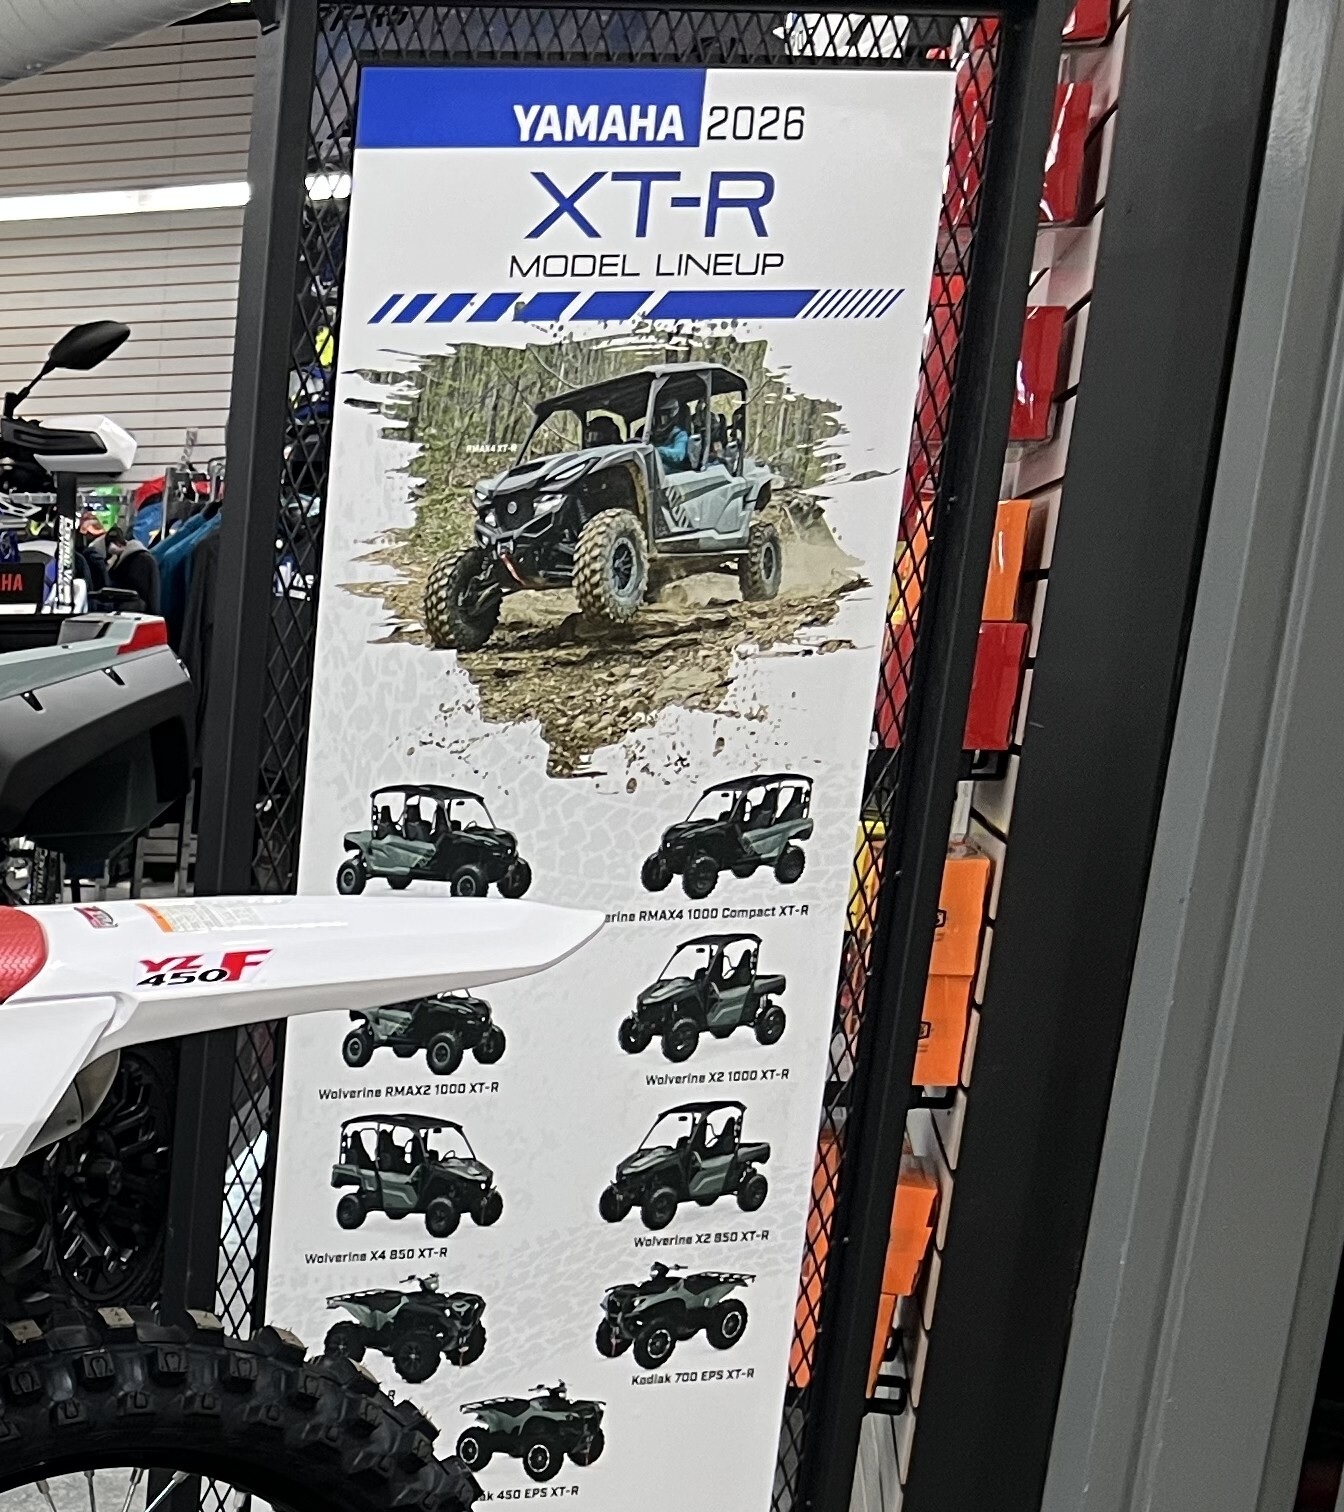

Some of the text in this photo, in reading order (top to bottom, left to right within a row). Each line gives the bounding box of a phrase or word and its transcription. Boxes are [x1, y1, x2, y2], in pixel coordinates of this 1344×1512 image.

[513, 104, 806, 142] YAMAHA 2026
[523, 170, 776, 239] XT-R
[509, 253, 785, 278] MODEL LINEUP
[638, 909, 684, 922] RMAX4
[687, 907, 718, 920] 1000
[721, 905, 776, 920] Compact
[778, 904, 810, 917] XT-R
[136, 968, 228, 987] 450
[645, 1068, 790, 1086] Wolverine X2 1000 XT-R
[318, 1081, 499, 1100] Wolverine RMAX2 1000 XT-R
[633, 1229, 770, 1248] Wolverine X2 850 XT-R
[304, 1247, 448, 1264] Wolverine X4 850 XT-R
[631, 1367, 755, 1386] Kodiak 700 EPS XT-R
[496, 1489, 521, 1500] 450
[524, 1487, 548, 1499] EPS
[550, 1485, 580, 1498] XT-R
